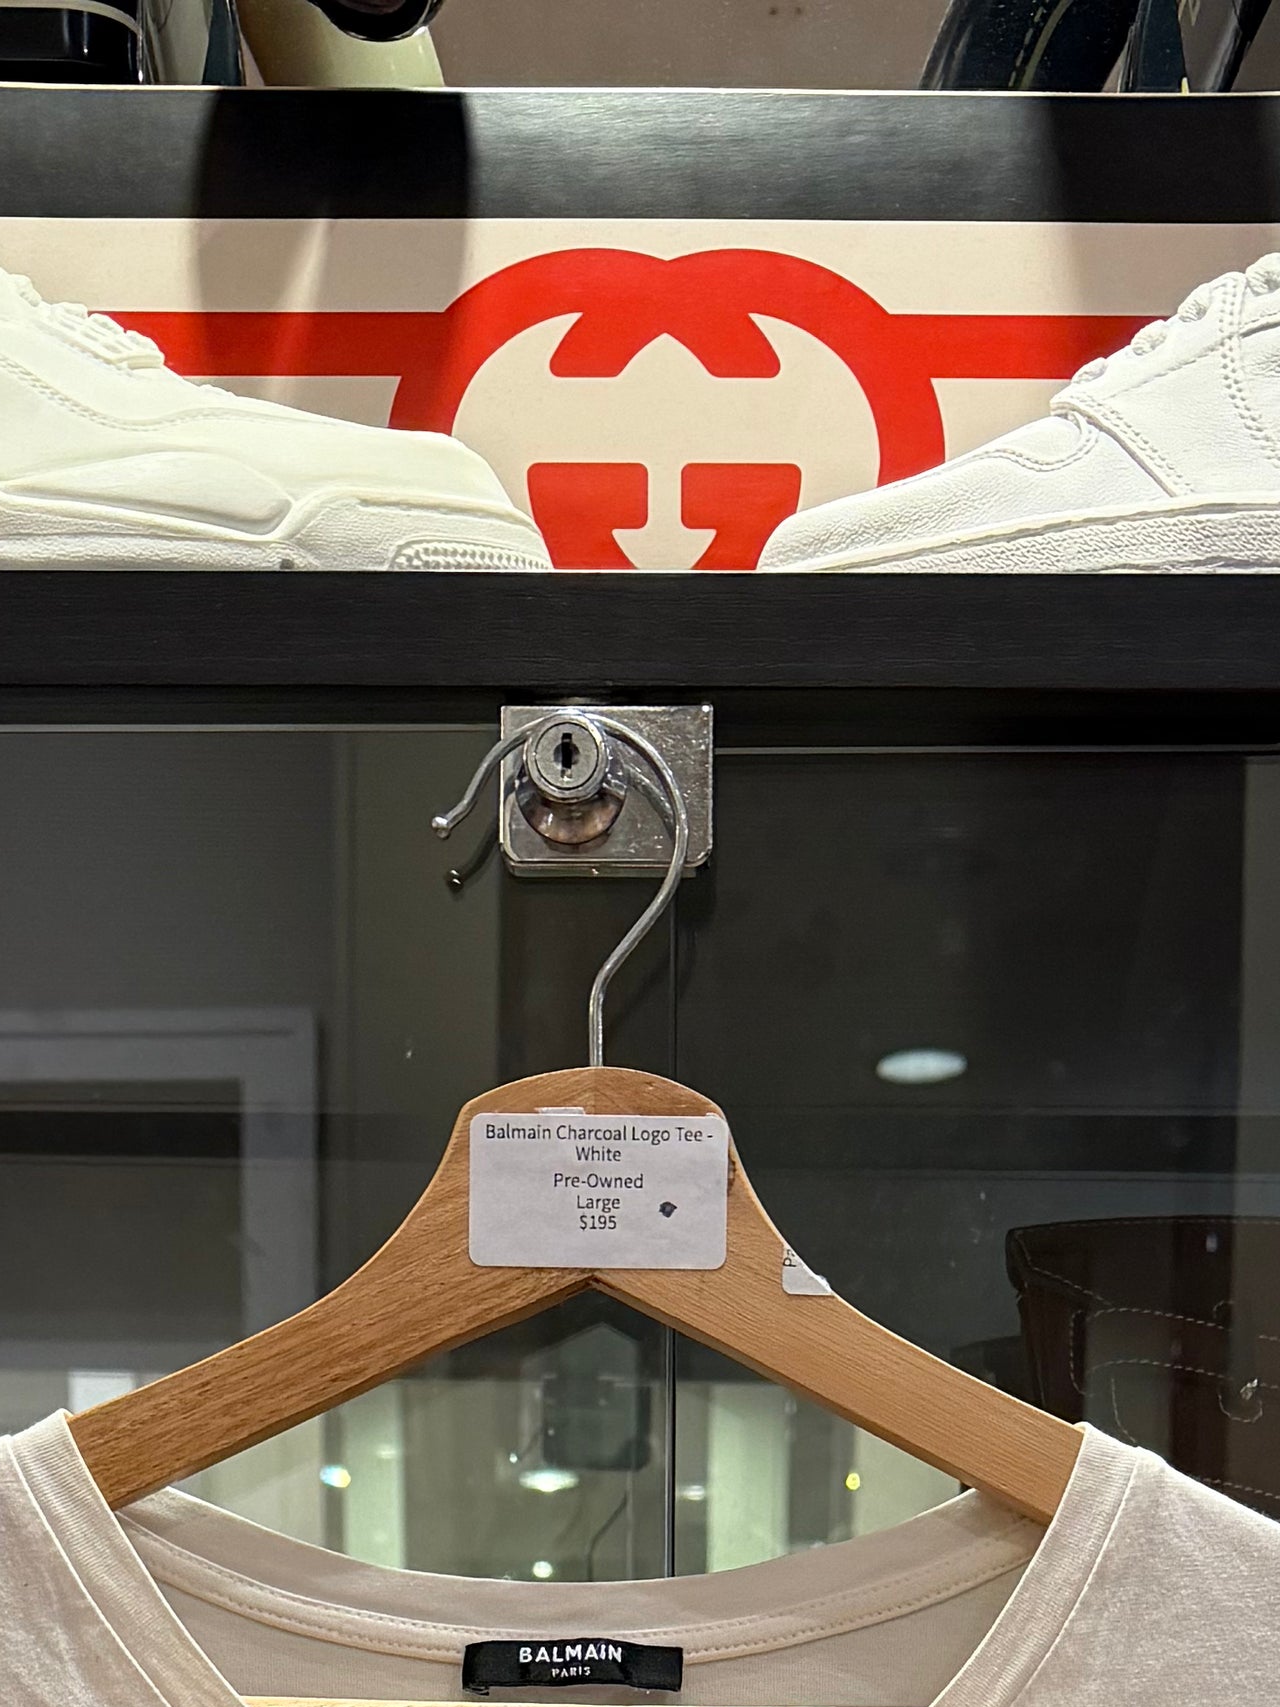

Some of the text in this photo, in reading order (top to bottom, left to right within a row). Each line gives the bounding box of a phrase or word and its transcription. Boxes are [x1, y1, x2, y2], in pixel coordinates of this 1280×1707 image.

[485, 1123, 552, 1140] Balmain
[556, 1124, 627, 1142] Charcoal
[631, 1126, 671, 1146] Logo
[675, 1126, 704, 1142] Tee
[575, 1145, 622, 1162] White
[553, 1172, 644, 1189] Pre-Owned
[576, 1194, 621, 1213] Large
[579, 1214, 618, 1231] $195
[518, 1643, 622, 1664] BALMAIN
[551, 1665, 592, 1678] PARIS
